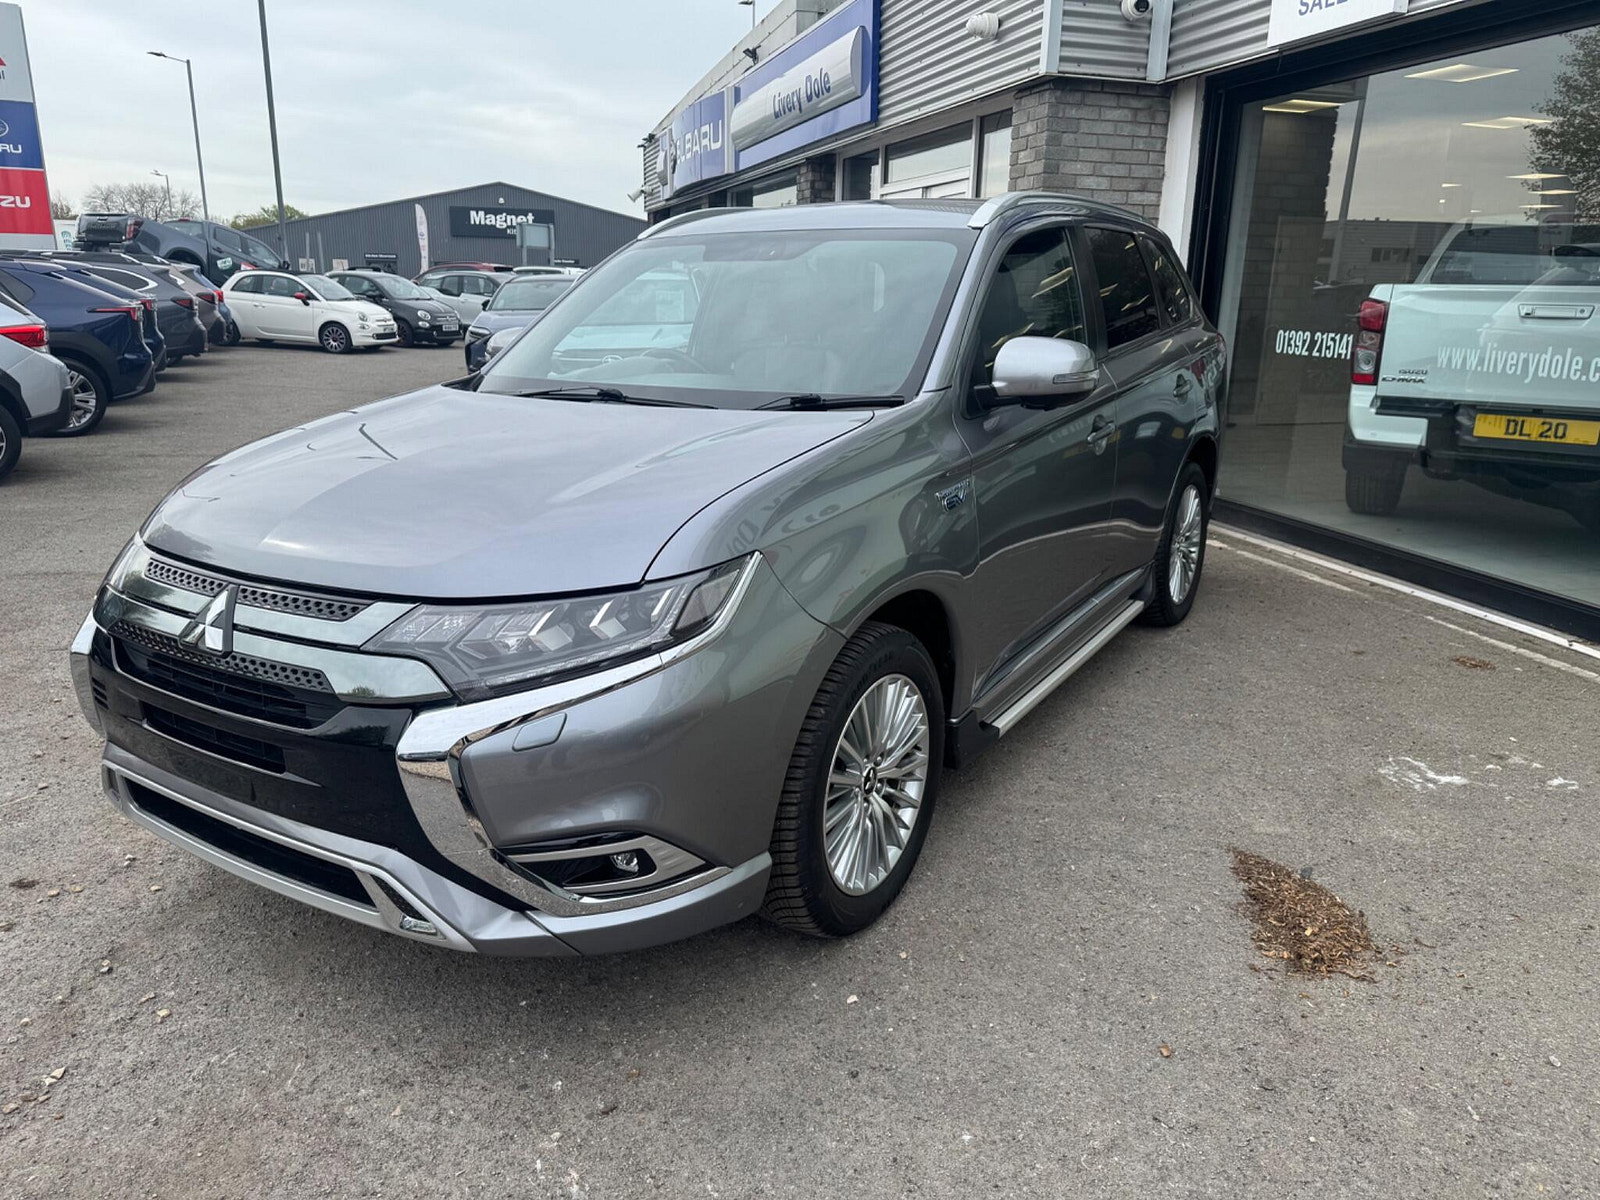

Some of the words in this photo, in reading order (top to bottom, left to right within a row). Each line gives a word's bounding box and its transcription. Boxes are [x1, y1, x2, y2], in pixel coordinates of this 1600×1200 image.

[1298, 0, 1349, 16] SA
[773, 87, 802, 119] Livery
[805, 67, 831, 103] Dole
[469, 209, 535, 229] Magnet
[1276, 329, 1311, 356] 01392
[1312, 332, 1354, 360] 215141
[1504, 418, 1531, 438] DL
[1538, 421, 1568, 440] 20
